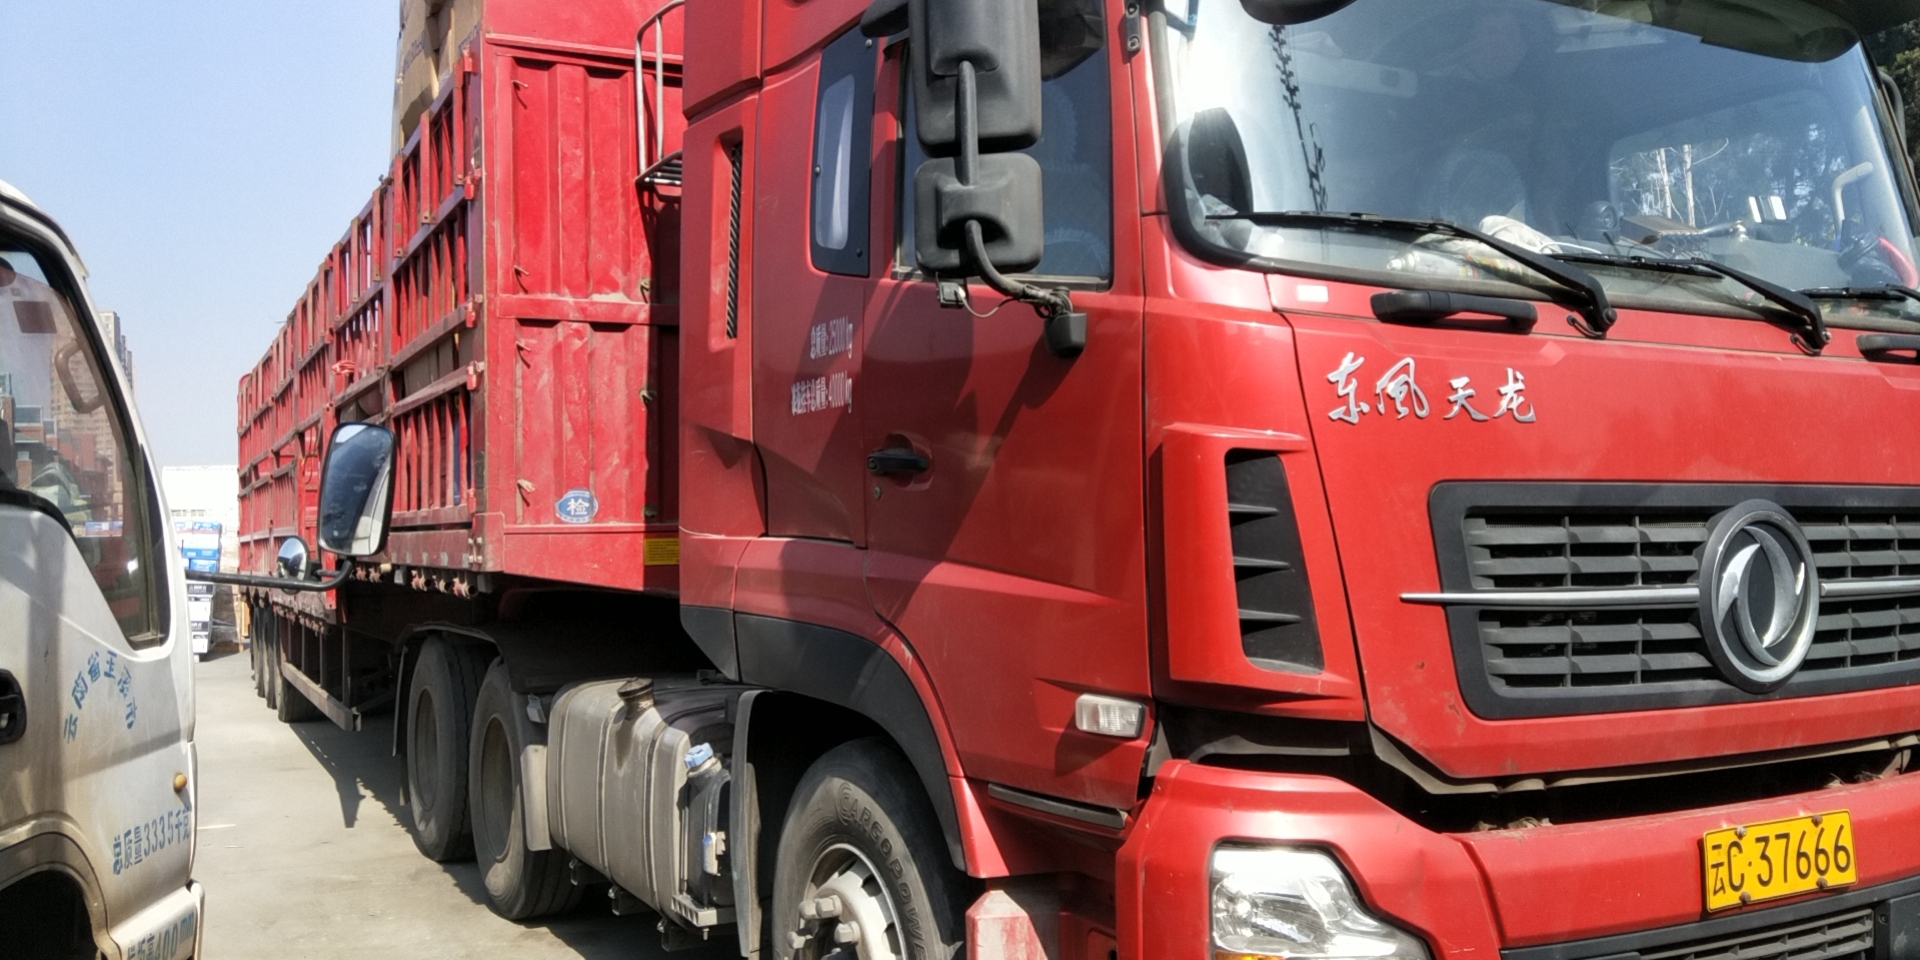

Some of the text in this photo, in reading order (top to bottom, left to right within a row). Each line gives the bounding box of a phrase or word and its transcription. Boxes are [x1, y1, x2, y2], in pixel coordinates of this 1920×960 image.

[566, 498, 590, 516] 检
[112, 805, 191, 875] 总质量3335千克
